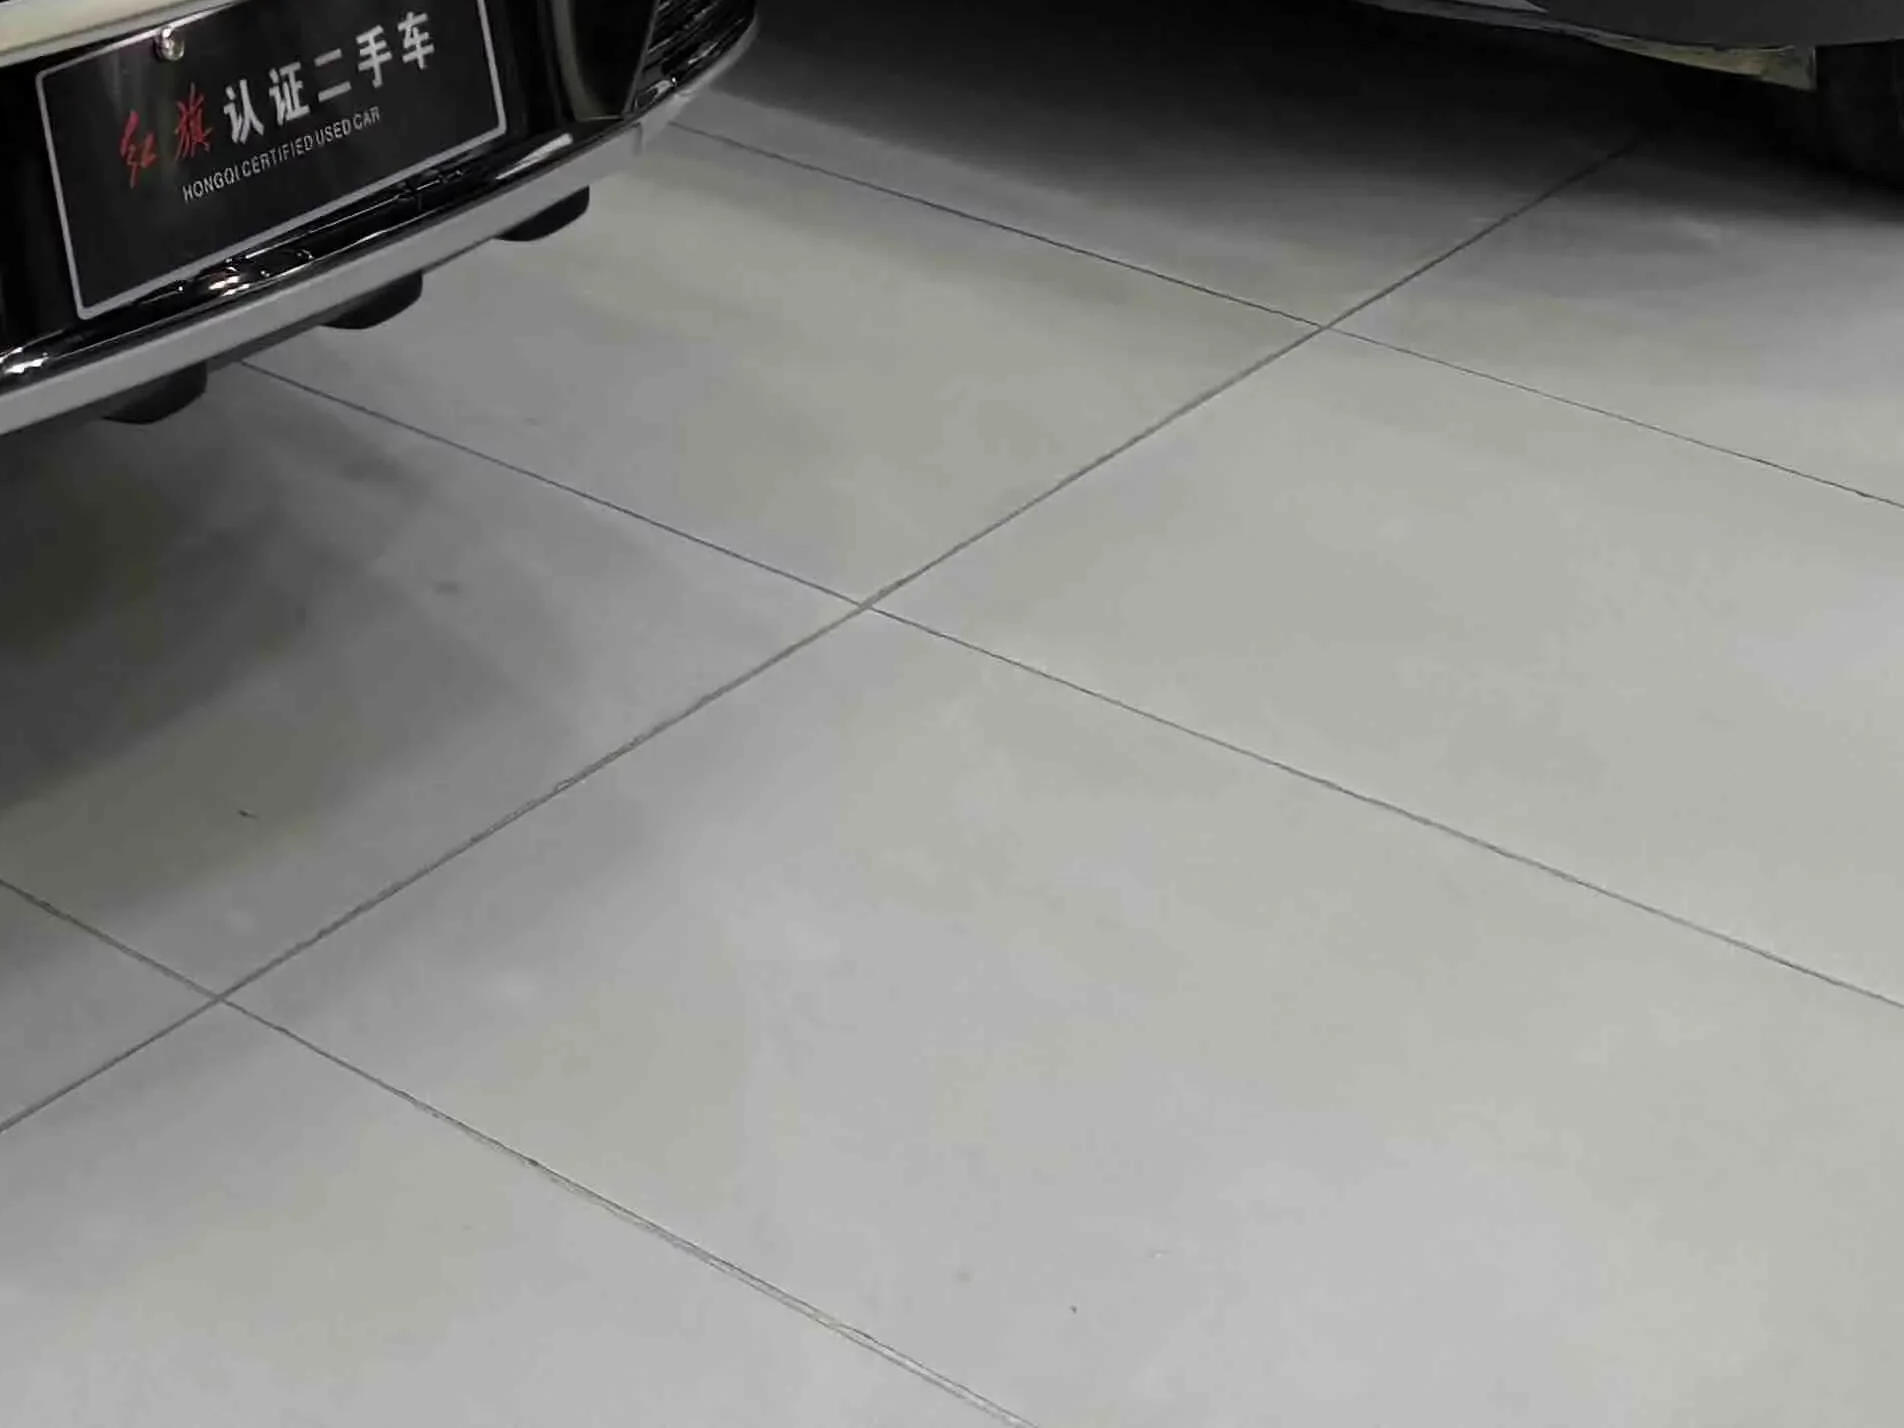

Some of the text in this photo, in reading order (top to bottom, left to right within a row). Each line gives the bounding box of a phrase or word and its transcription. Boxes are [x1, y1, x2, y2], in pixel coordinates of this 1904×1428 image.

[181, 105, 381, 204] HONGQI CERTIFIED USED CAR
